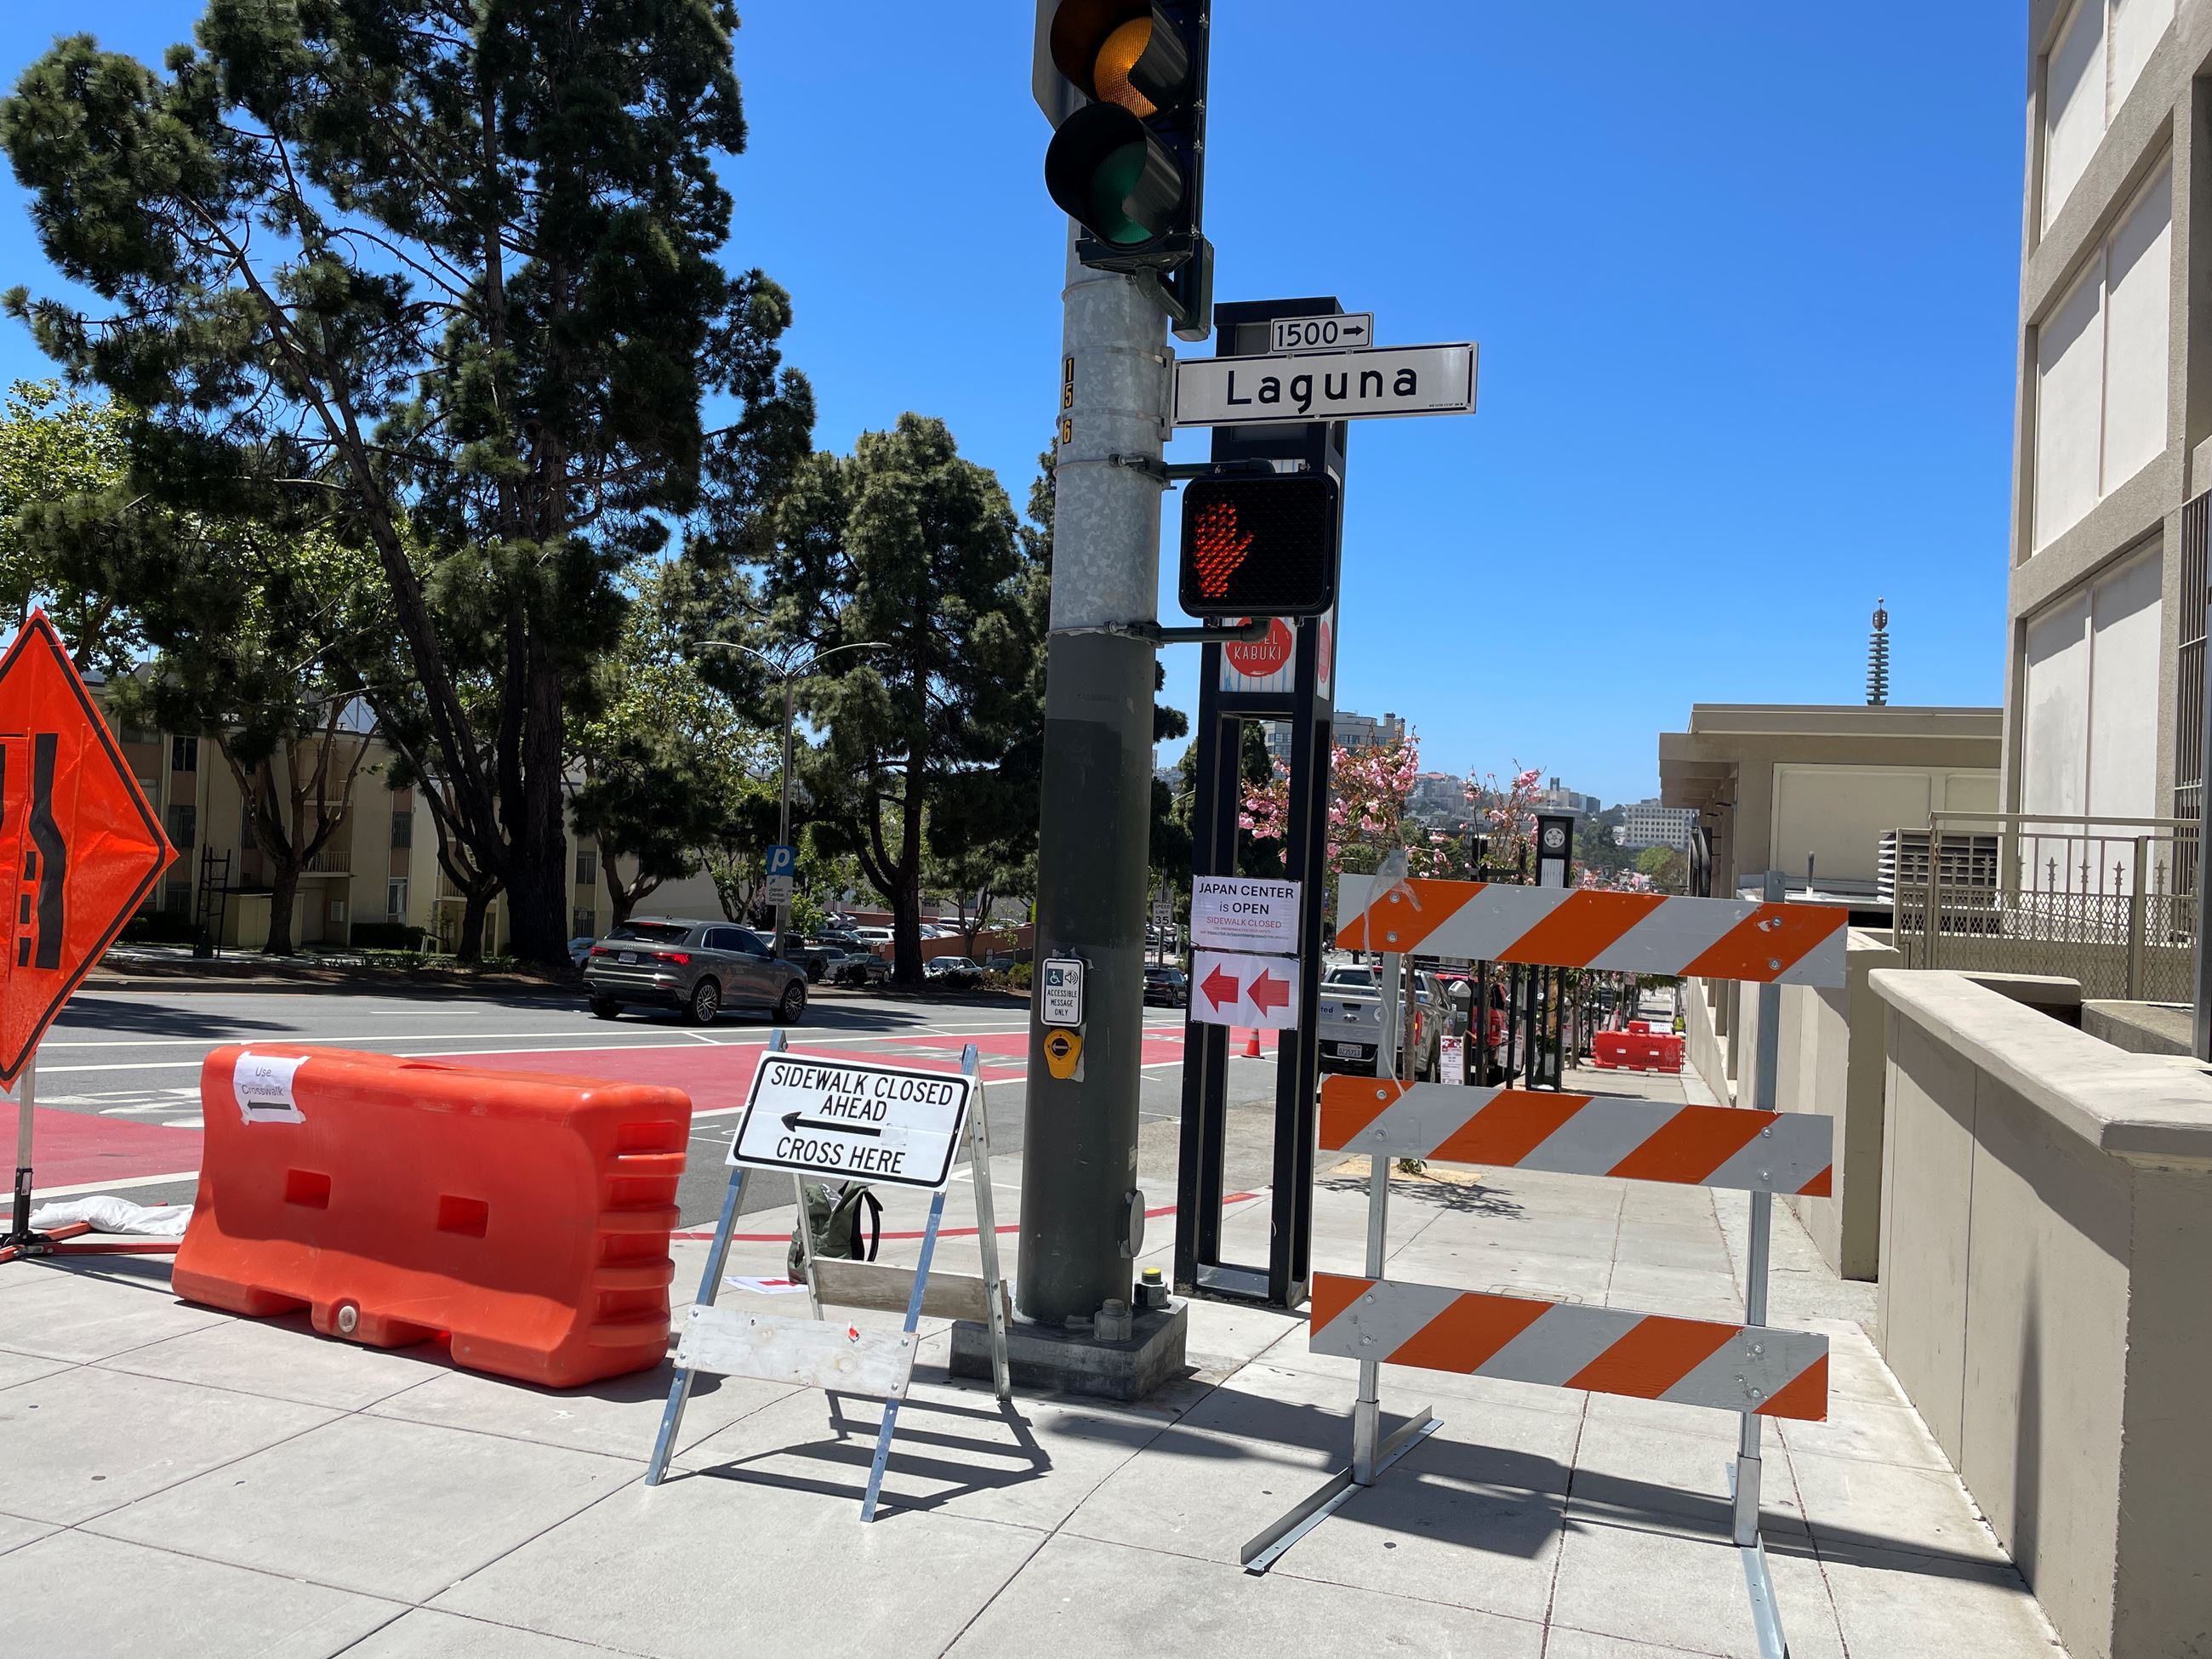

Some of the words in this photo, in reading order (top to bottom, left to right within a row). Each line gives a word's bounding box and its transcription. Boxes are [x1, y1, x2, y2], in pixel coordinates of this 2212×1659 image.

[1278, 321, 1338, 346] 1500
[1227, 368, 1417, 414] Laguna
[1234, 646, 1281, 660] KABUKI
[1199, 882, 1237, 895] JAPAN
[1240, 885, 1294, 899] CENTER
[1219, 901, 1229, 913] is
[1232, 903, 1269, 915] OPEN
[1155, 916, 1169, 924] 35
[1206, 916, 1246, 926] SIDEWALK
[1248, 919, 1282, 928] CLOSED
[1047, 989, 1077, 998] ACCESSIBLE
[1050, 999, 1073, 1007] MESSAGE
[255, 1066, 272, 1077] Use
[241, 1084, 285, 1097] Crosswalk
[770, 1065, 869, 1096] SIDEWALK
[874, 1076, 954, 1106] CLOSED
[819, 1094, 887, 1121] AHEAD
[776, 1136, 845, 1166] CROSS
[848, 1145, 906, 1174] HERE
